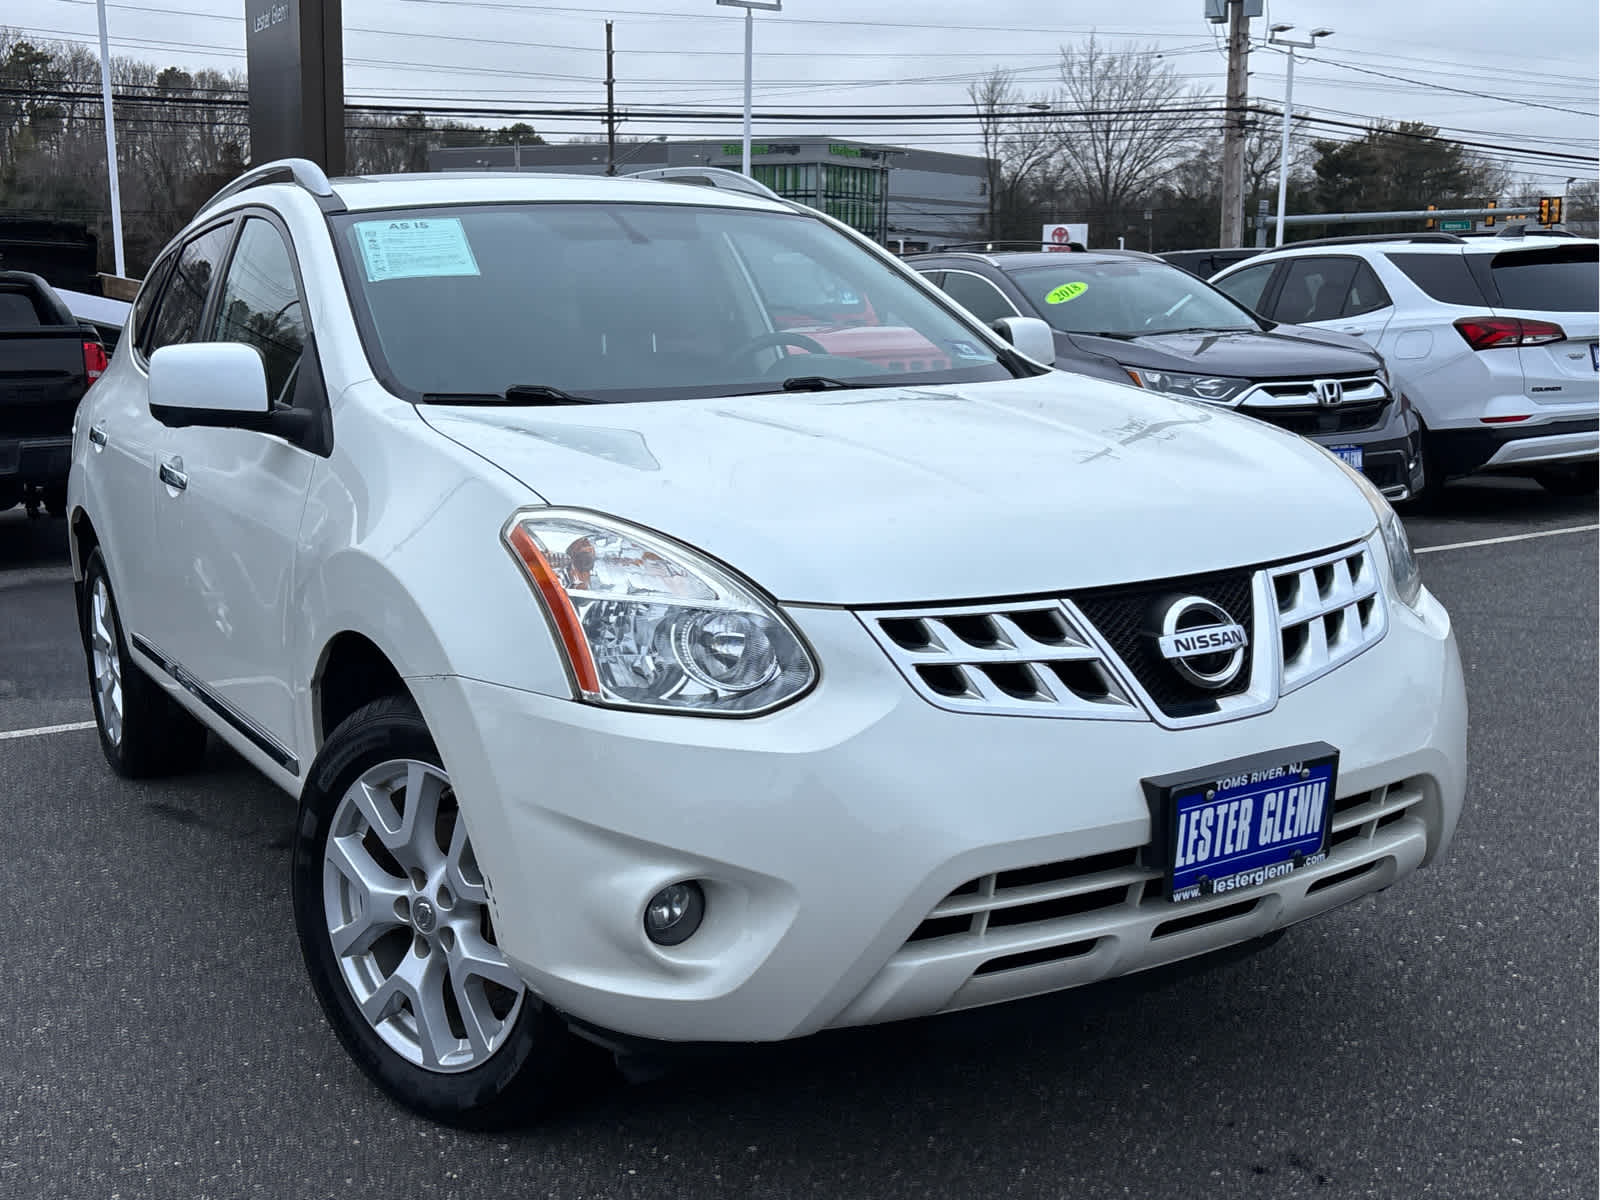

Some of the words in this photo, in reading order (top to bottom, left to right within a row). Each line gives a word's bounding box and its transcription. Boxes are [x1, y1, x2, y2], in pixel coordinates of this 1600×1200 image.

[389, 222, 410, 230] AS
[414, 221, 429, 229] IS
[1053, 284, 1081, 301] 2018
[1174, 629, 1243, 652] NISSAN
[1216, 775, 1248, 791] TOMS
[1288, 762, 1304, 775] NJ
[1175, 798, 1254, 868] LESTER
[1258, 781, 1327, 846] GLENN
[1212, 861, 1294, 894] lesterglenn
